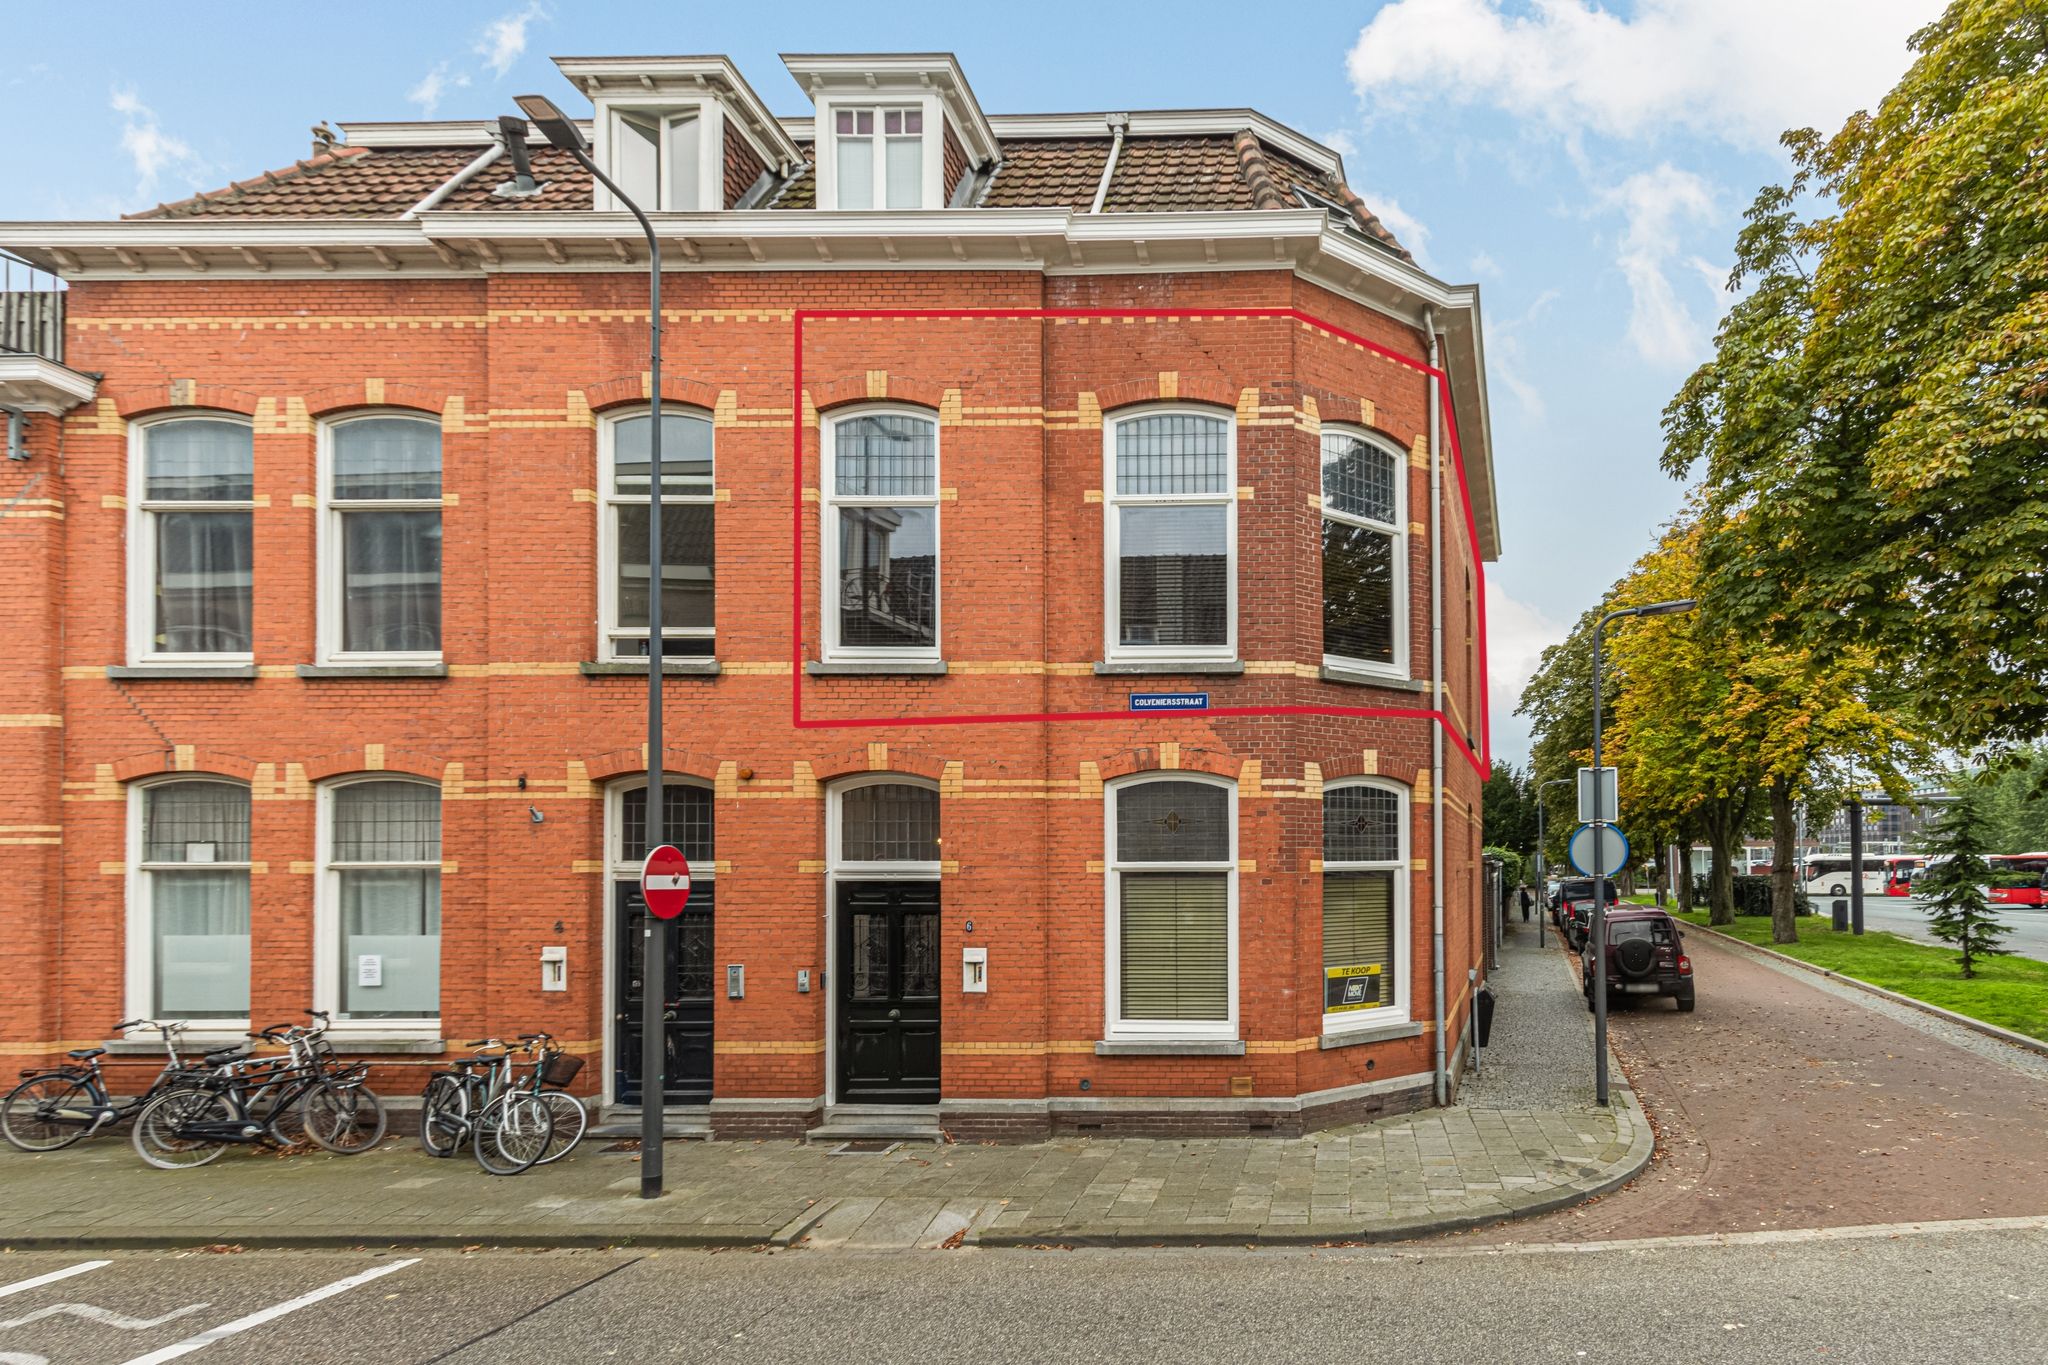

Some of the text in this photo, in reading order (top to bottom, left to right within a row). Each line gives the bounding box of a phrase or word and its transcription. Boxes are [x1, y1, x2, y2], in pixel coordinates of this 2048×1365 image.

[966, 921, 972, 932] 6
[1341, 966, 1371, 976] TE KOOP
